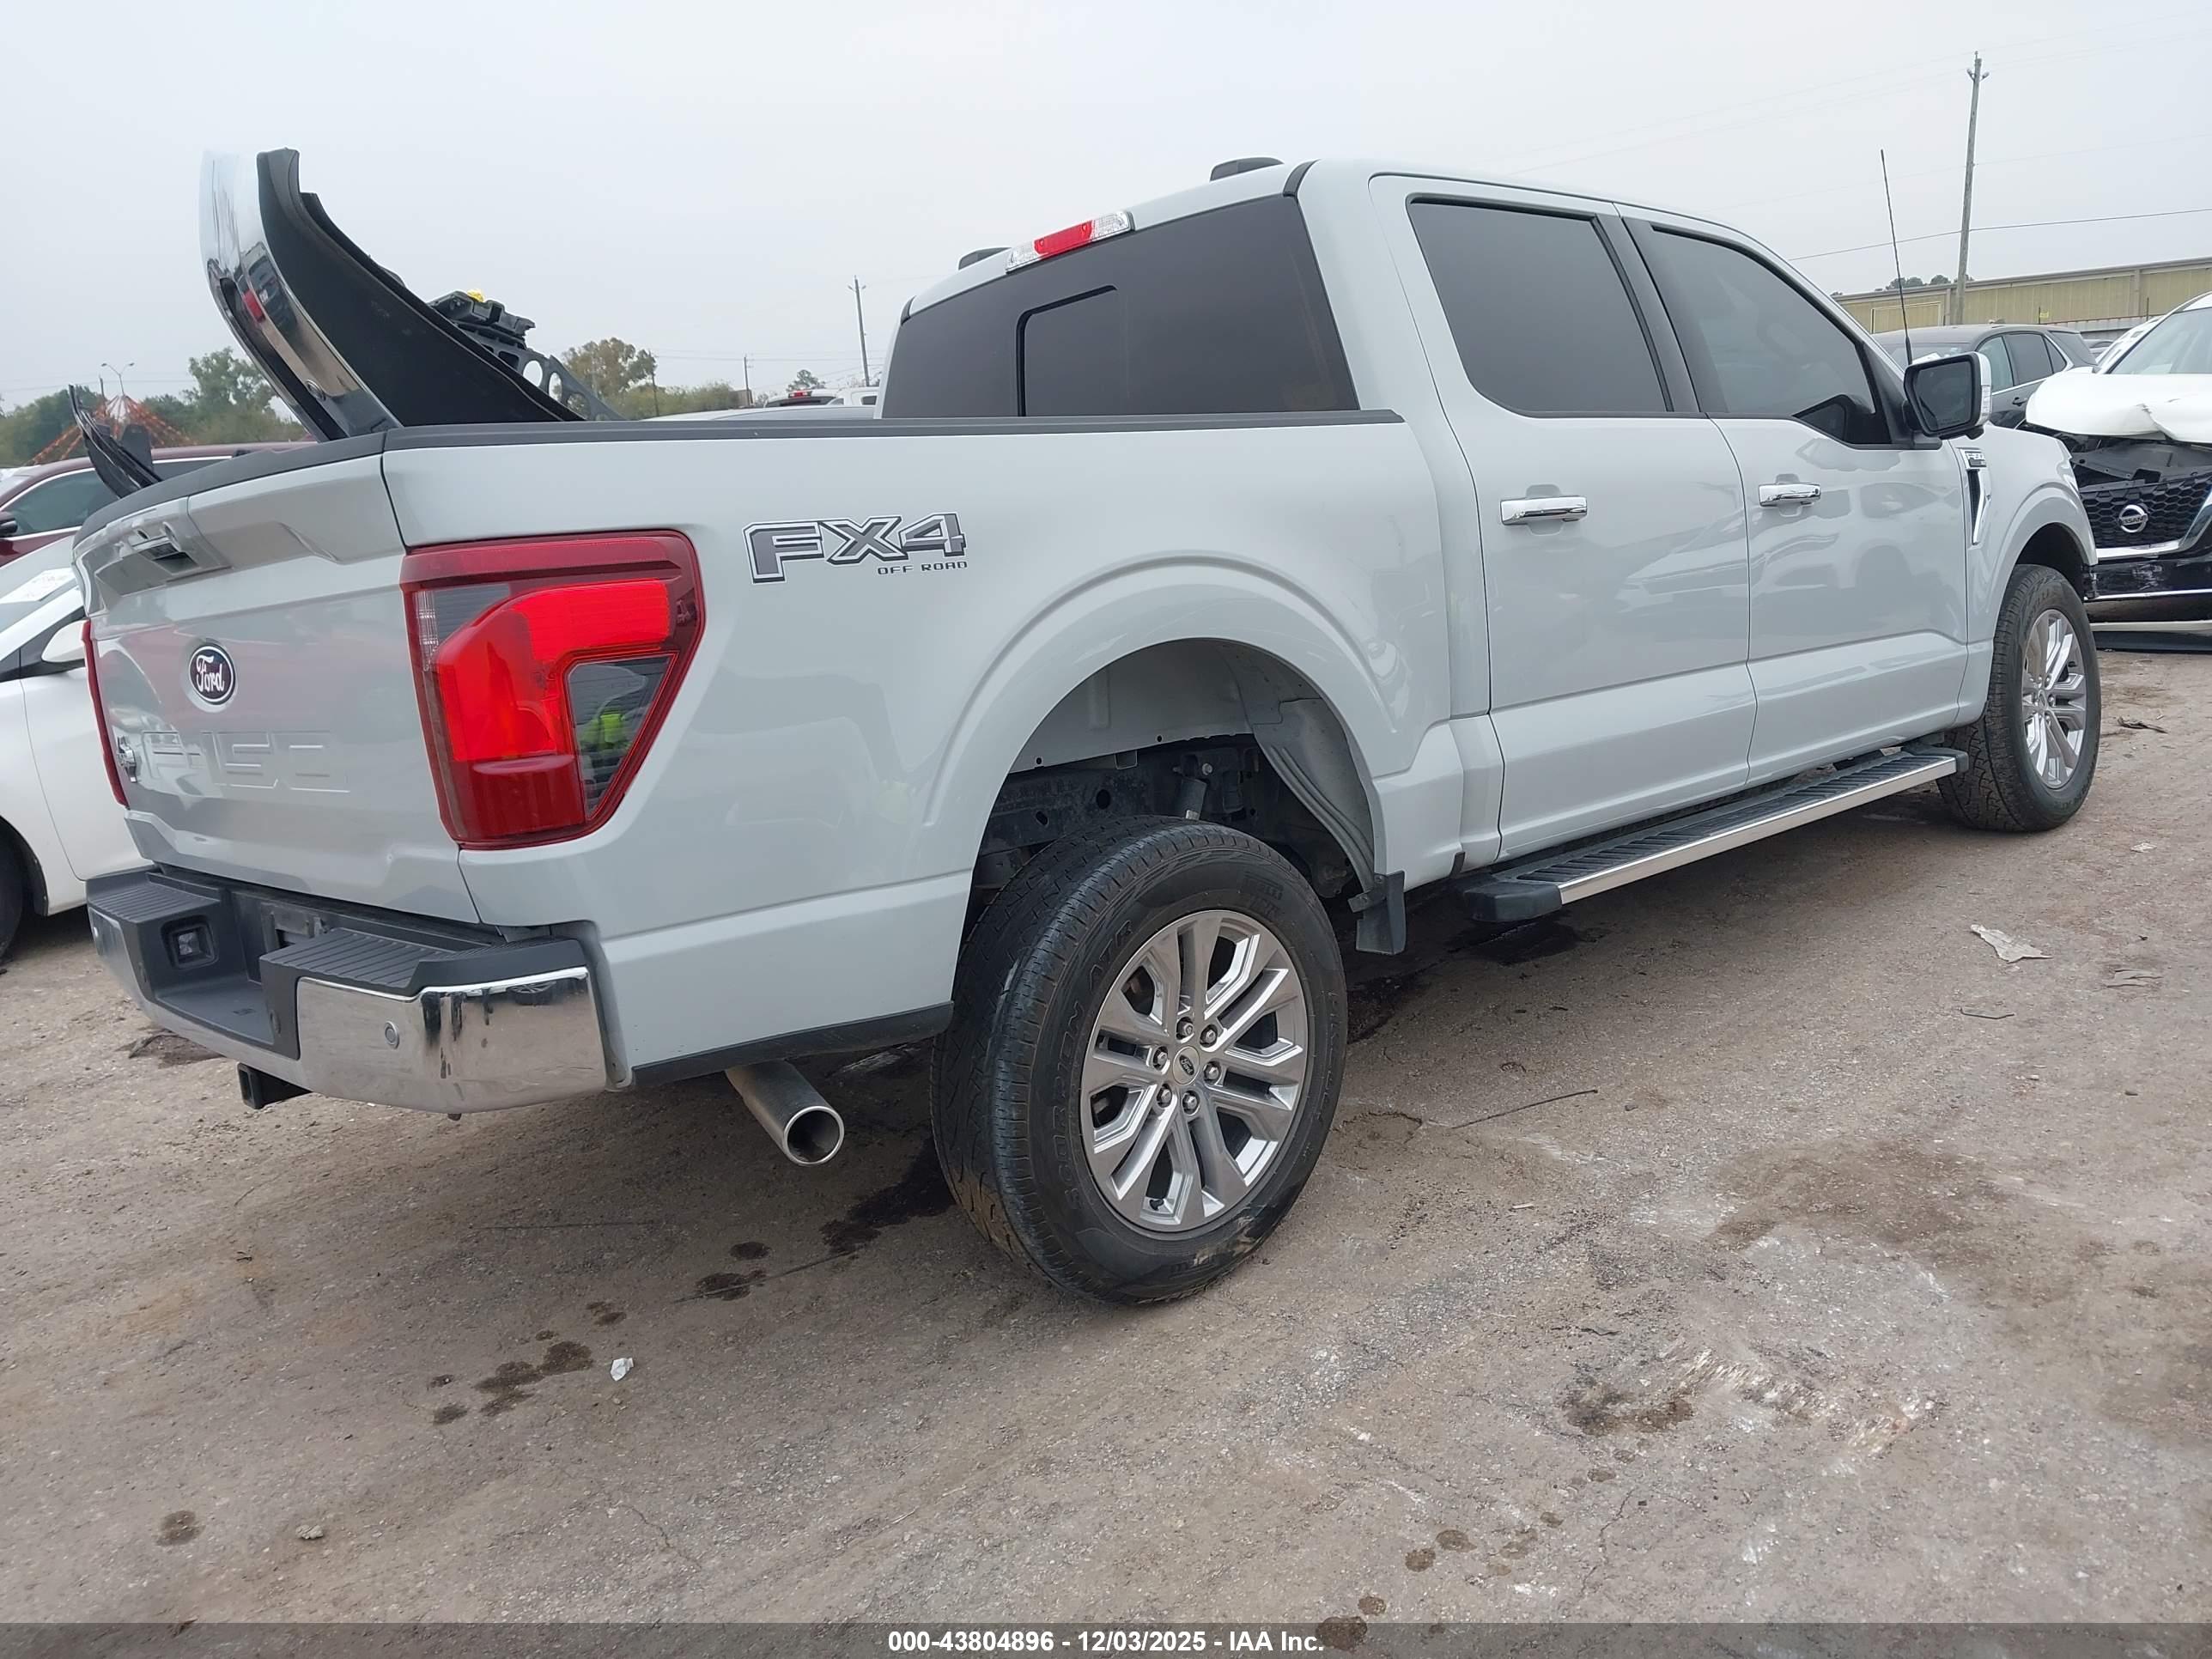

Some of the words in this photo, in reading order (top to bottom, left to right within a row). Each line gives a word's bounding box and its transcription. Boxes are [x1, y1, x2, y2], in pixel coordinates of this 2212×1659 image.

[742, 512, 967, 585] FX4
[877, 564, 915, 576] OFF
[921, 560, 969, 573] ROAD
[195, 653, 226, 693] Ford
